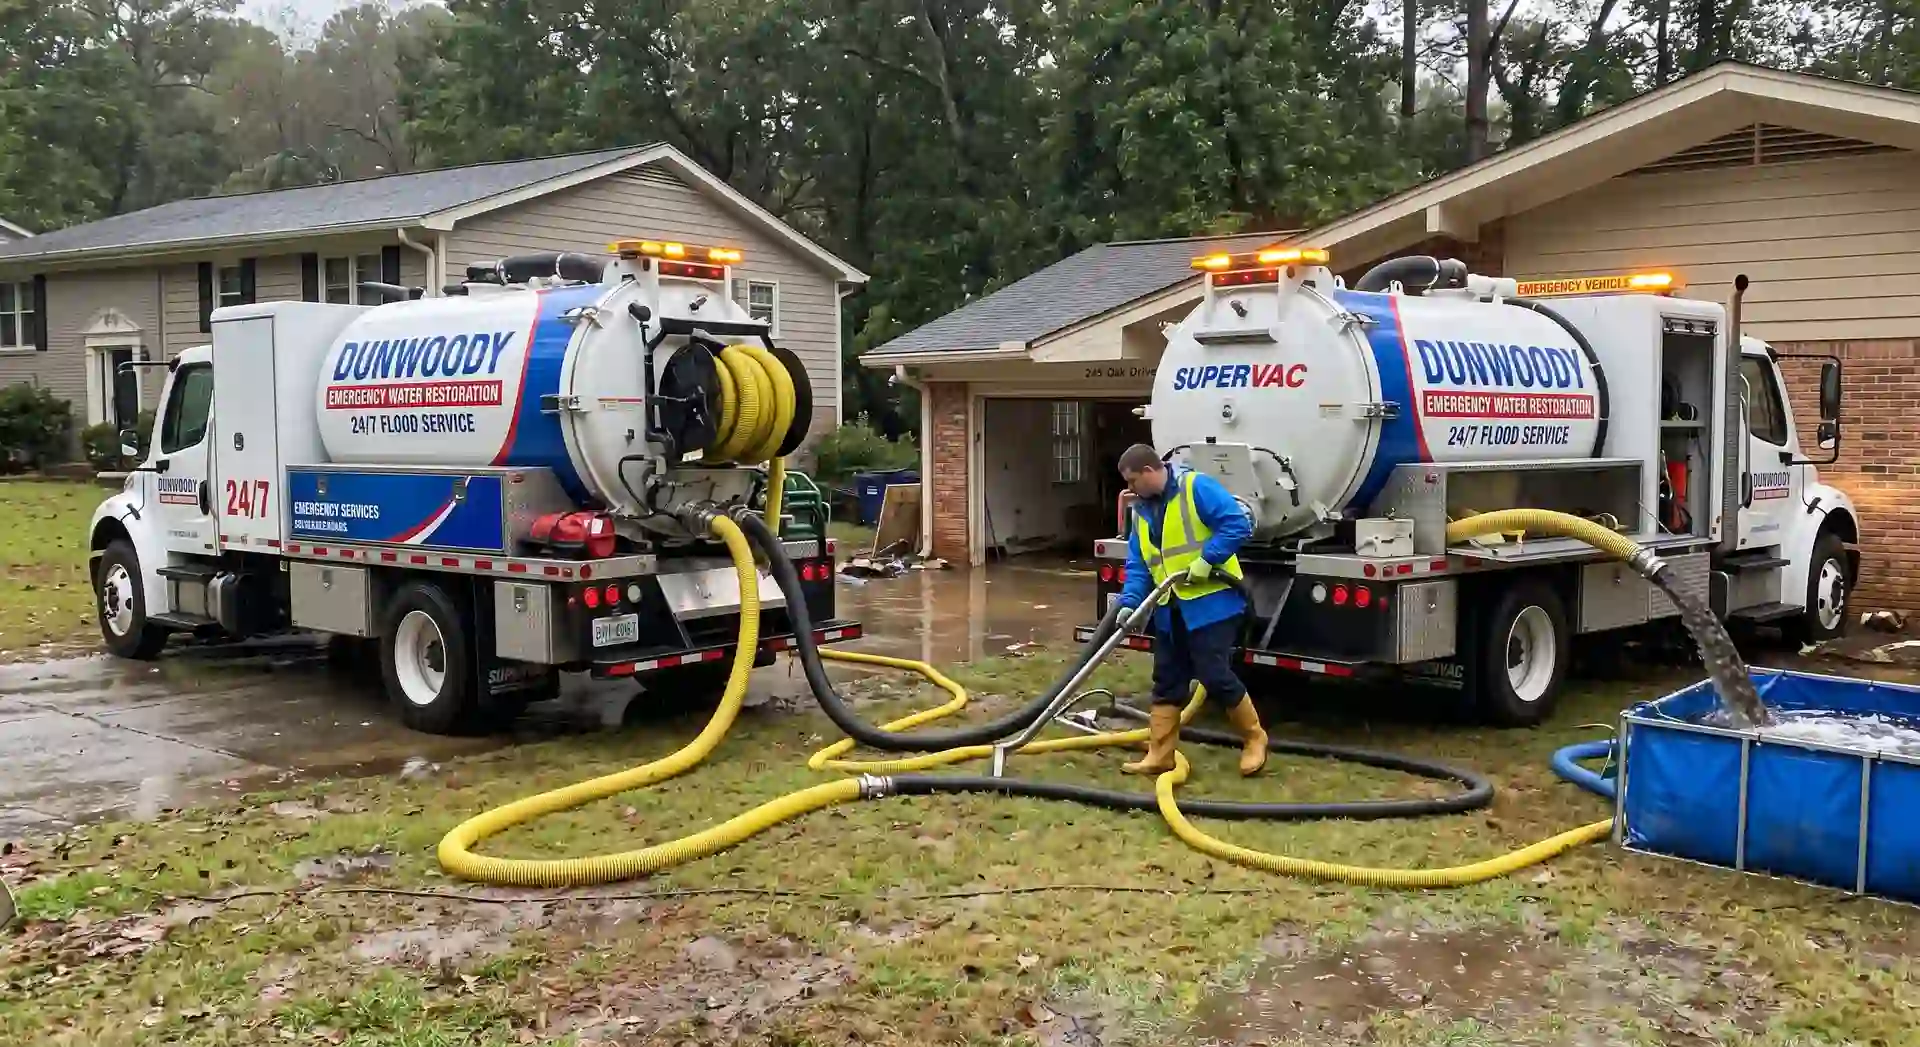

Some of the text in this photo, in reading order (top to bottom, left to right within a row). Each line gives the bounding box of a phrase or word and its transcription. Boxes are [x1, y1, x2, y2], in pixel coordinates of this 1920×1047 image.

[1517, 280, 1582, 295] EMERGENCY
[333, 331, 516, 381] DUNWOODY
[1415, 339, 1584, 388] DUNWOODY
[1107, 367, 1125, 377] Oak
[1173, 363, 1308, 391] SUPERVAC
[328, 384, 498, 406] EMERGENCY WATER RESTORATION
[1426, 395, 1592, 415] EMERGENCY WATER RESTORATION
[351, 413, 475, 435] 24/7 FLOOD SERVICE
[1448, 425, 1570, 447] 24/7 FLOOD SERVICE
[158, 478, 197, 492] DUNWOODY
[1753, 472, 1791, 487] DUNWOODY
[226, 479, 270, 519] 24/7
[294, 502, 380, 519] EMERGENCY SERVICES
